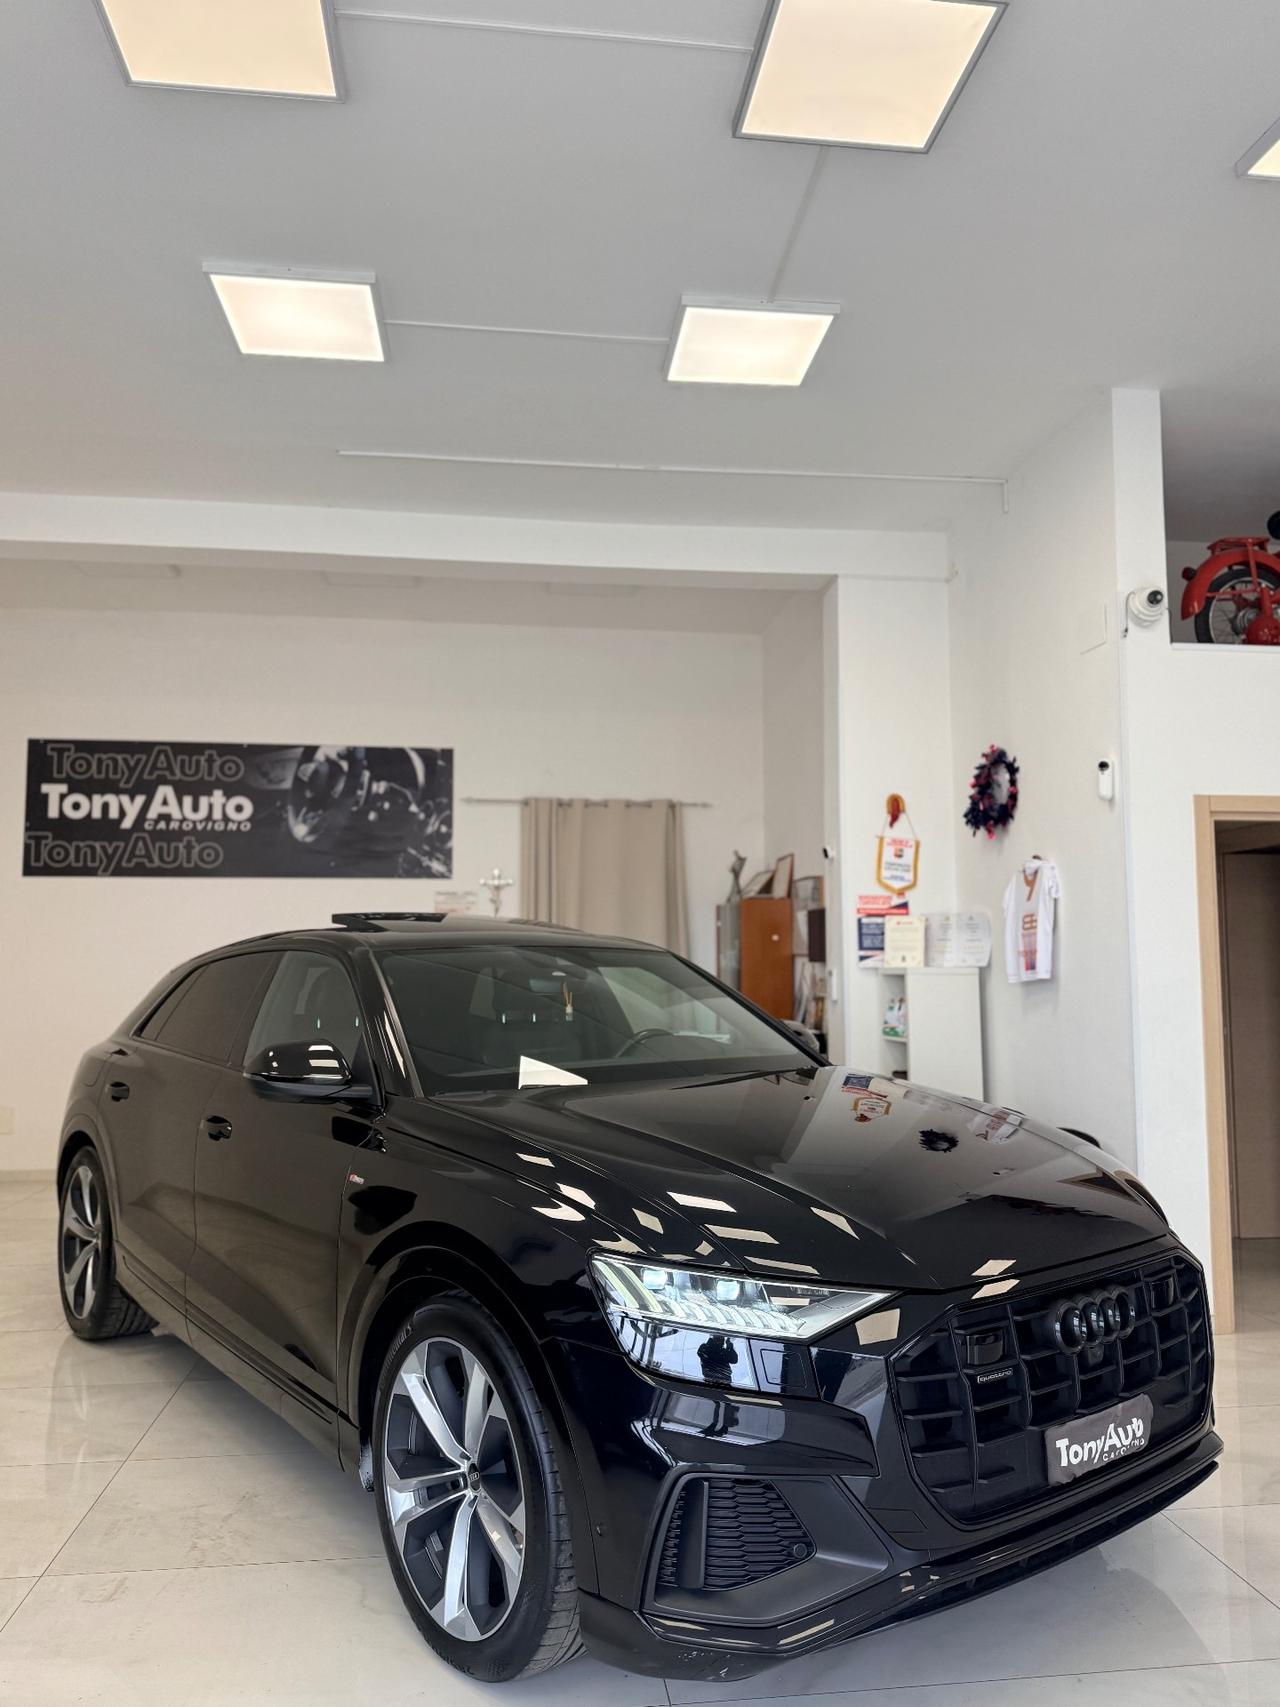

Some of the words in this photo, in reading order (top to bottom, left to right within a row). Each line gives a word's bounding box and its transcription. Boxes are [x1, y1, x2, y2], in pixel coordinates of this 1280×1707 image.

[46, 743, 245, 788] TonyAuto
[41, 783, 254, 830] TonyAuto
[143, 820, 253, 832] CAROVIGNO
[25, 831, 224, 876] TonyAuto
